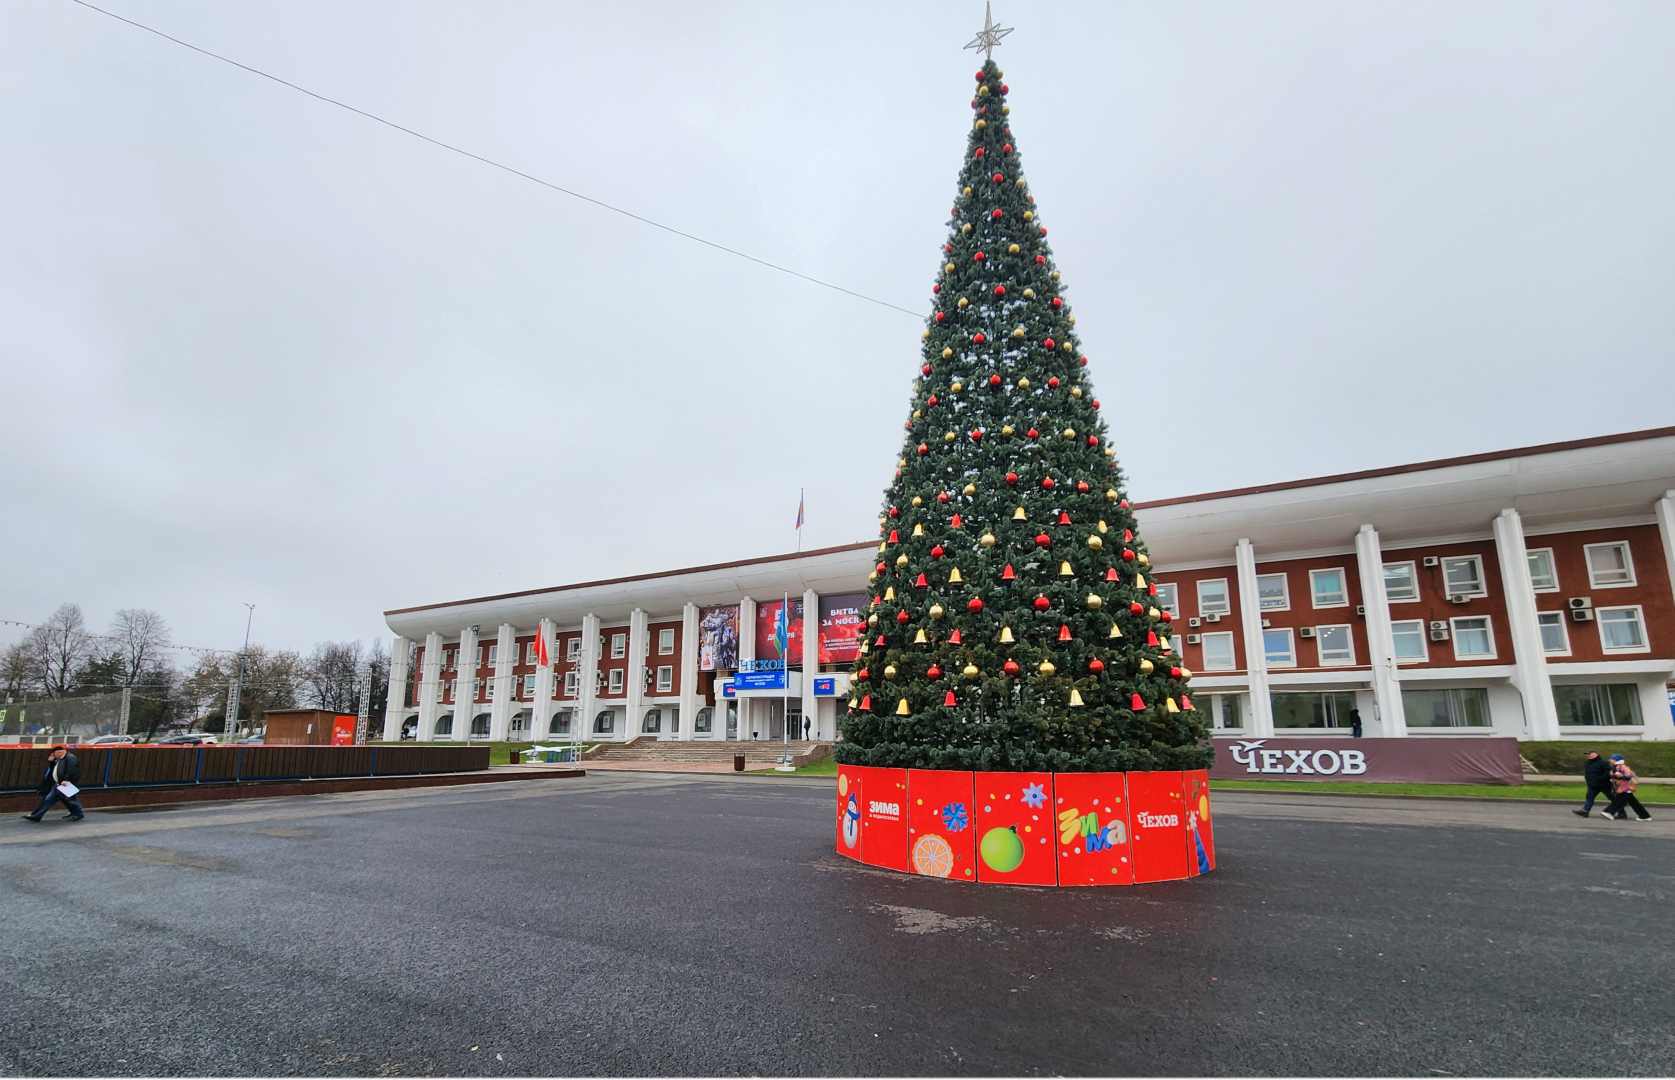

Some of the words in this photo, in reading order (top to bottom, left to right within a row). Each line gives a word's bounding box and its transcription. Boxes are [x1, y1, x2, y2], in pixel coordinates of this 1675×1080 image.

[830, 607, 860, 617] БИТВА
[821, 619, 833, 627] ЗА
[767, 632, 795, 642] ДЕРЯ
[740, 659, 786, 671] ЧЕХОВ
[1229, 741, 1367, 775] ЧЕХОВ
[1137, 811, 1179, 828] ЧЕХОВ
